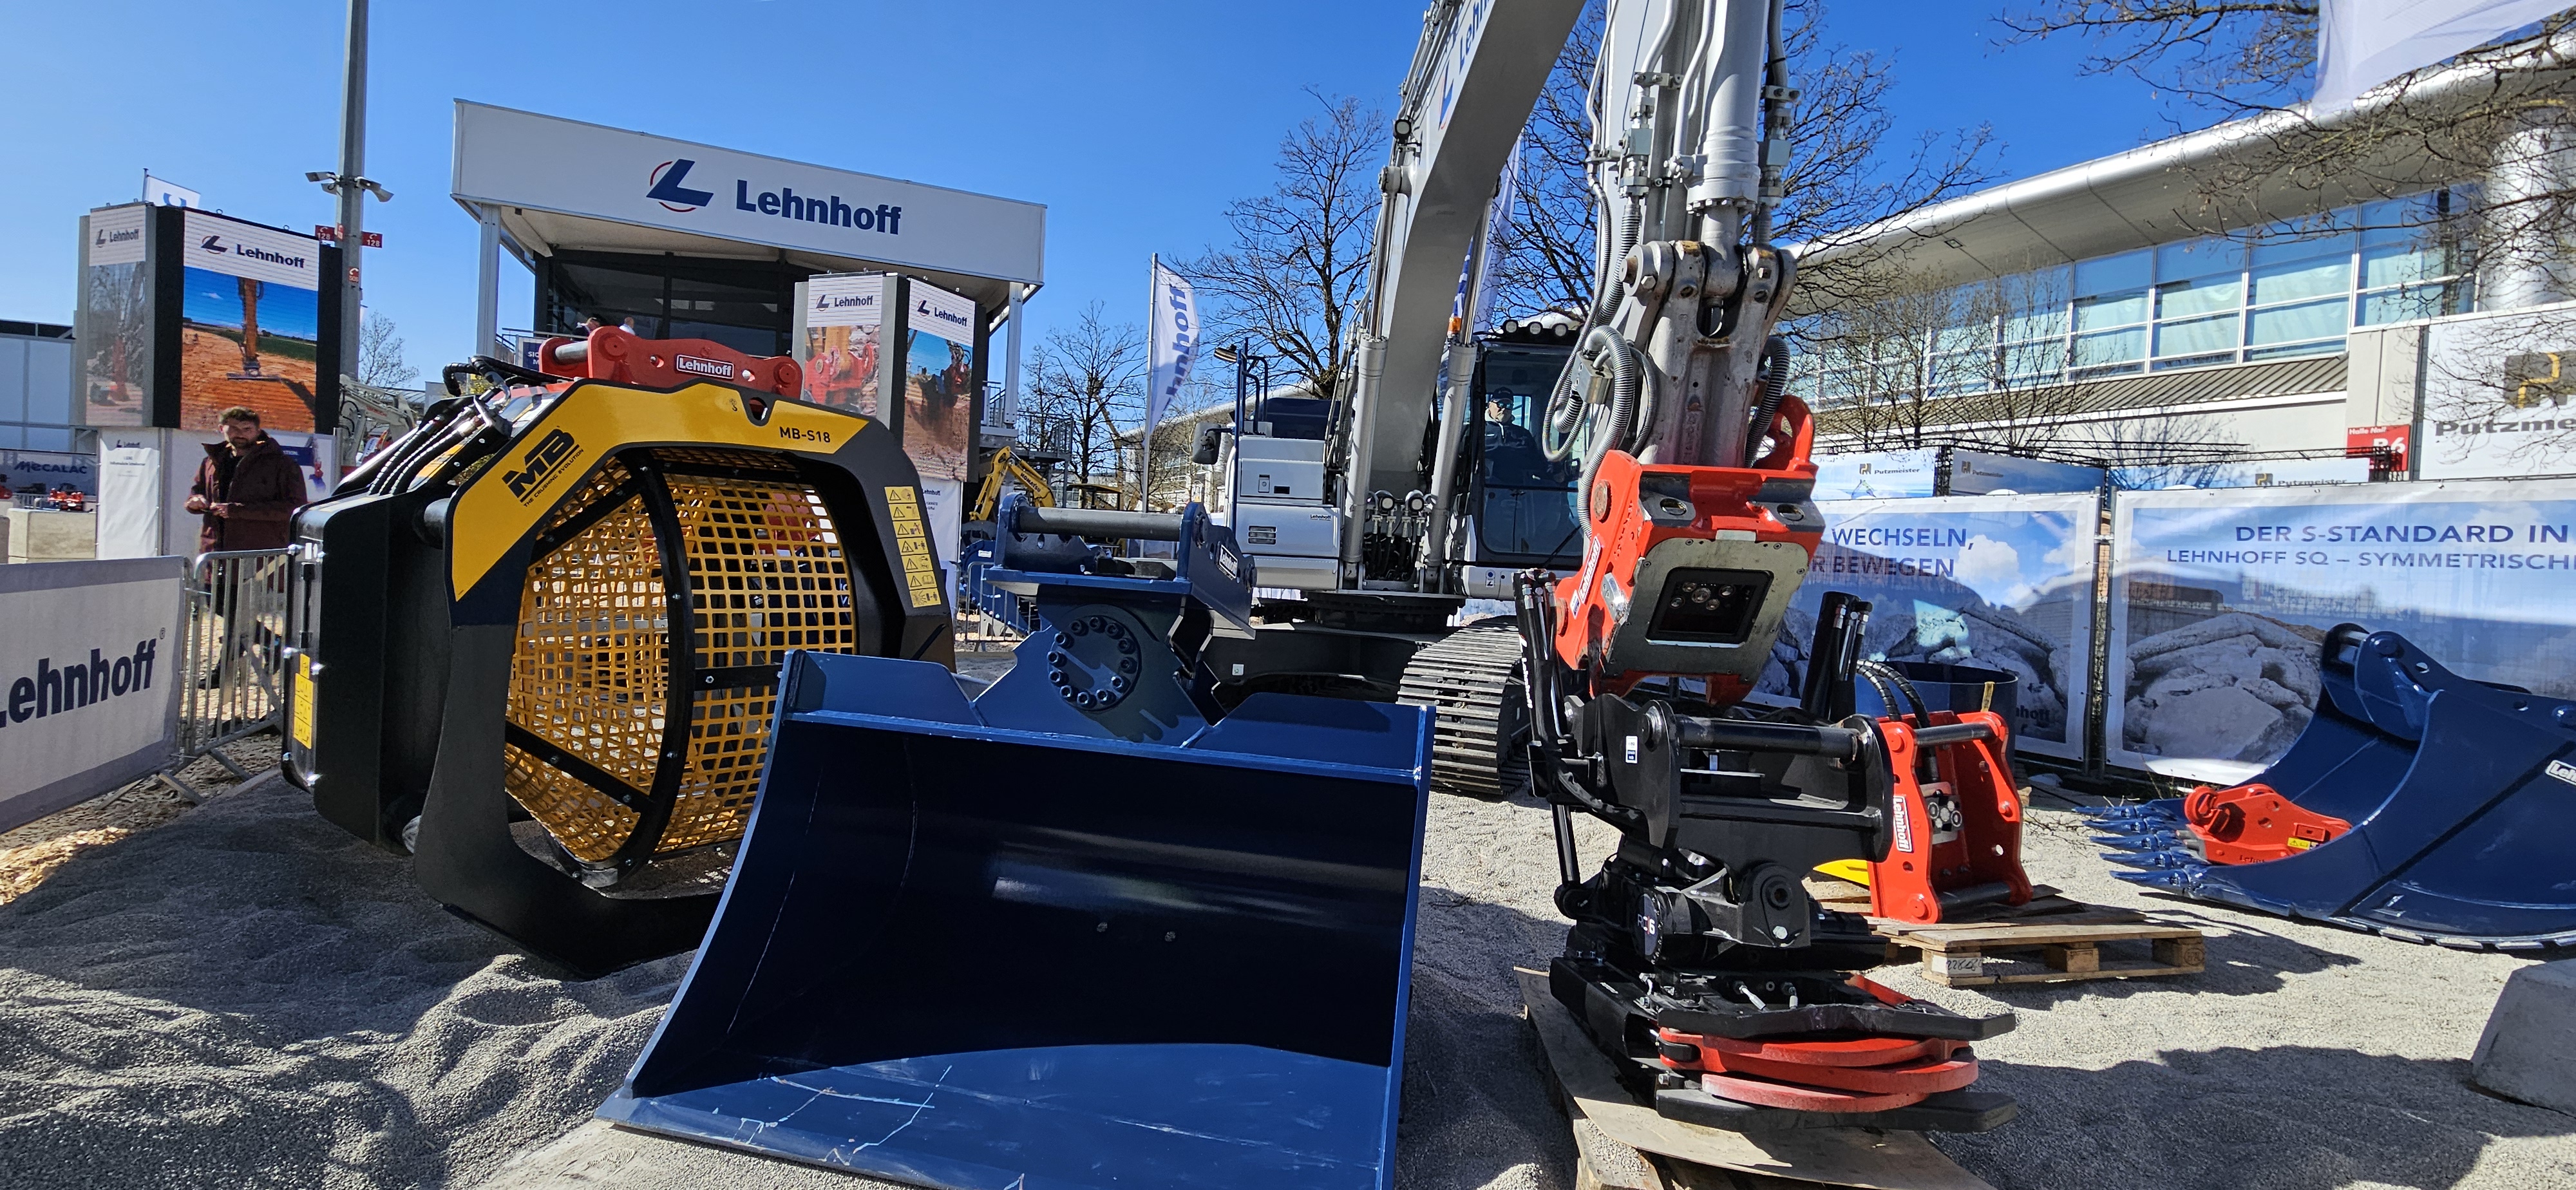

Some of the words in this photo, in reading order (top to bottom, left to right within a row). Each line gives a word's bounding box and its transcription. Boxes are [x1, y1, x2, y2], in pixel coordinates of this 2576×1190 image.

[736, 179, 902, 235] Lehnhoff
[109, 229, 140, 243] Lehnhoff
[366, 239, 380, 247] 128
[236, 243, 306, 269] Lehnhoff
[834, 295, 873, 307] Lehnhoff
[934, 307, 967, 326] Lehnhoff
[679, 357, 732, 377] Lehnhoff
[779, 426, 831, 443] MB-S18
[502, 429, 575, 499] MB
[1972, 469, 2004, 478] Putzmeister
[524, 498, 534, 507] THE
[534, 474, 558, 498] CRUSHING
[558, 448, 584, 475] EVOLUTION
[1021, 473, 1041, 493] KOMATSU
[1832, 528, 1974, 551] WECHSELN,
[2235, 526, 2291, 542] DER
[2301, 525, 2514, 543] S-STANDARD
[2529, 525, 2568, 543] IN
[1579, 540, 1600, 600] Lehnhoff
[1833, 556, 1955, 578] BEWEGEN
[2167, 549, 2287, 564] LEHNHOFF
[2295, 551, 2329, 565] SQ
[2358, 552, 2576, 570] SYMMETRISCH
[0, 638, 156, 729] ehnhoff
[1893, 798, 1909, 849] Lehnhoff
